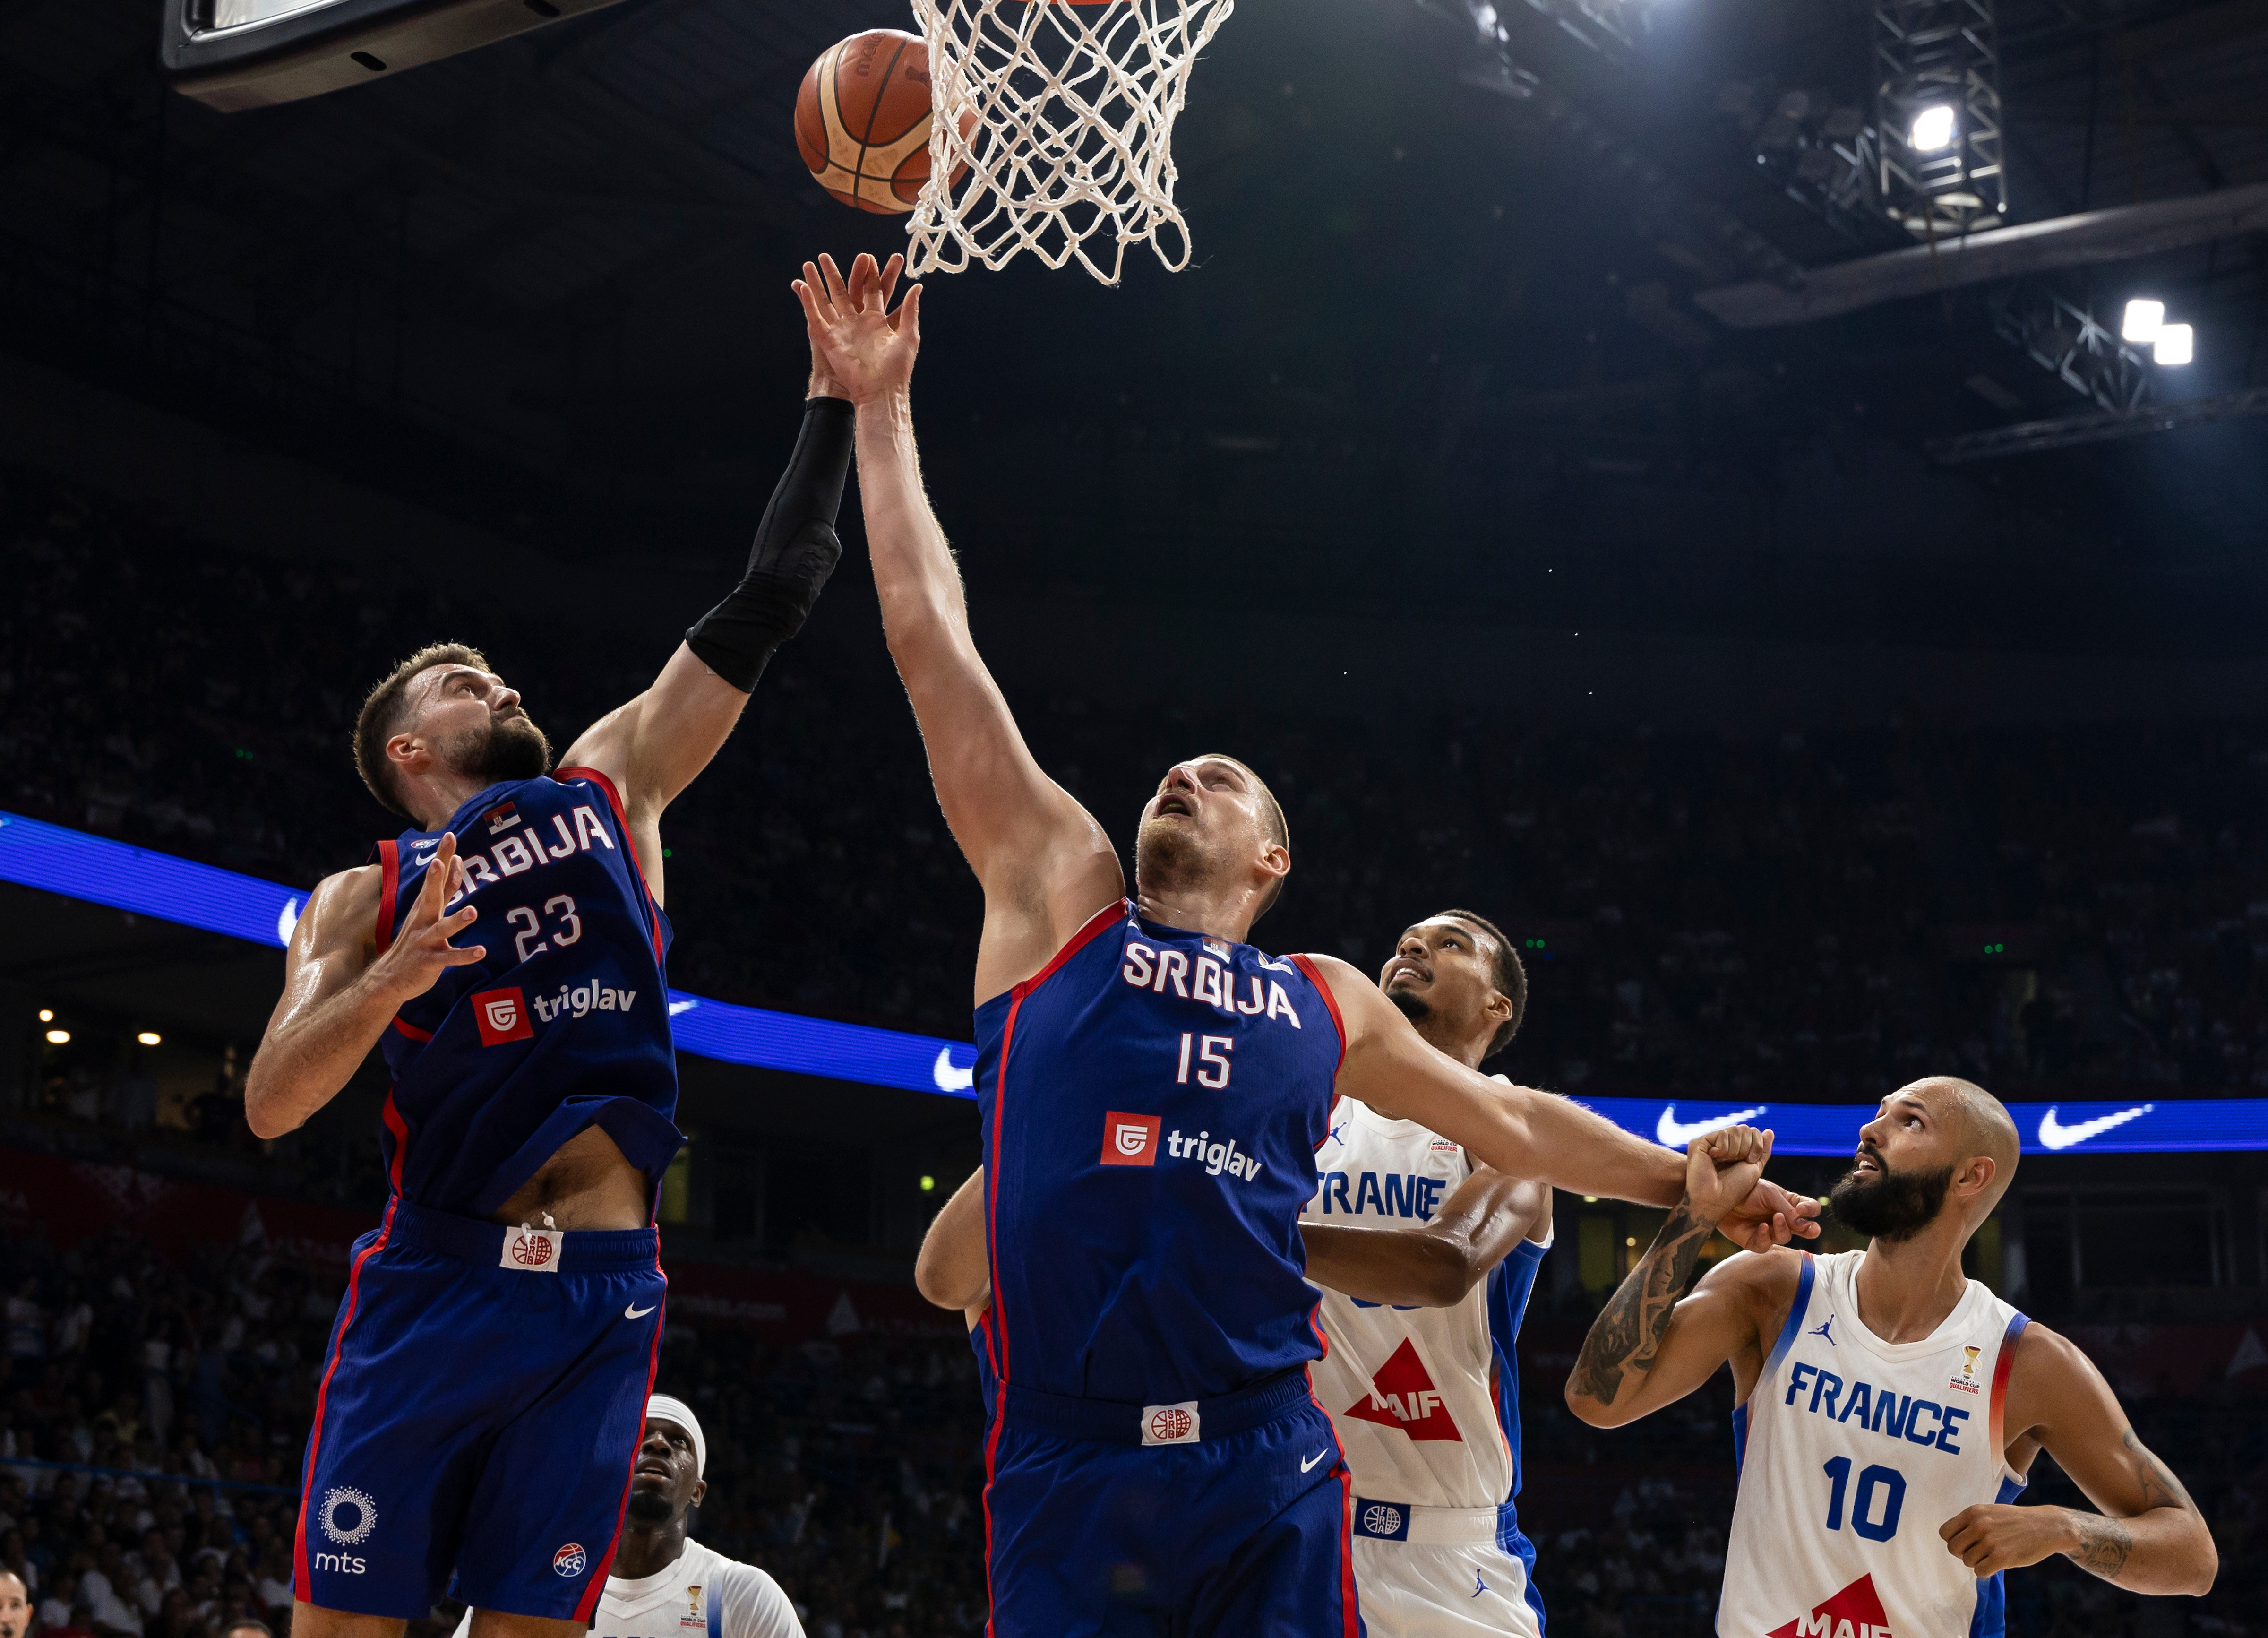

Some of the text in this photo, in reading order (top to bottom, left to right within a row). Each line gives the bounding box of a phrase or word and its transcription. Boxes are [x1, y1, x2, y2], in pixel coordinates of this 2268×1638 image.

[446, 805, 615, 907] RBIJA
[506, 894, 582, 963] 23
[533, 979, 636, 1022] triglav
[1123, 942, 1302, 1030] SRBIJA
[1176, 1032, 1234, 1090] 15
[1168, 1130, 1262, 1181] triglav
[1300, 1171, 1446, 1221] RANCE
[1371, 1390, 1440, 1421] MAIF
[1785, 1361, 1970, 1456] FRANCE
[1949, 1382, 1979, 1395] QUALIFIERS
[1377, 1506, 1387, 1535] FRA
[1823, 1455, 1907, 1543] 10
[315, 1552, 366, 1574] mts
